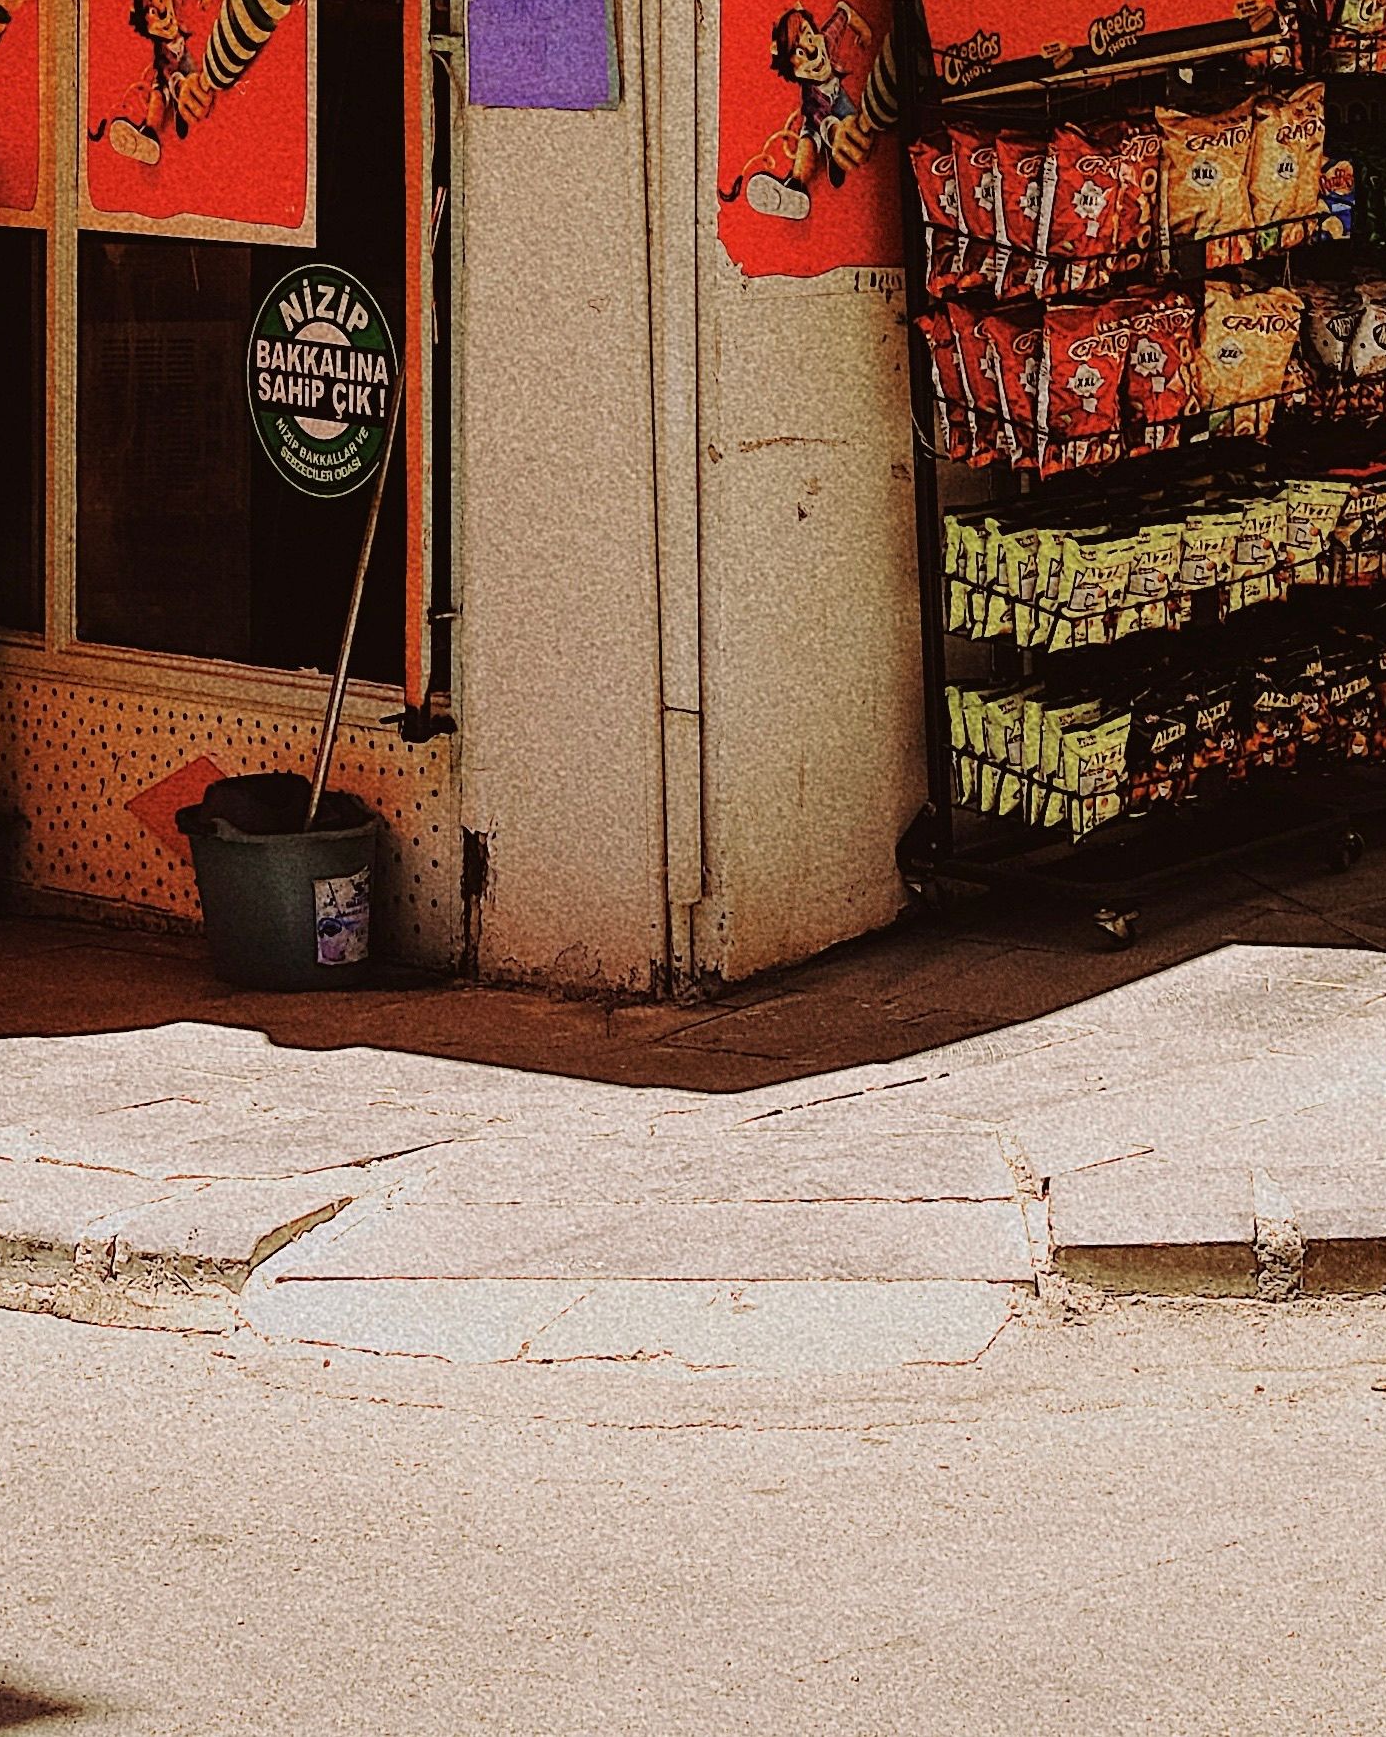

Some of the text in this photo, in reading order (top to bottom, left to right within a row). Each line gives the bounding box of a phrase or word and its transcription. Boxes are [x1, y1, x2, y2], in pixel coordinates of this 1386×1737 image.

[278, 278, 369, 333] NİZİP
[256, 339, 389, 386] BAKKALINA
[331, 382, 373, 420] ÇIK
[299, 440, 359, 467] BAKKALLAR
[354, 425, 370, 445] VE
